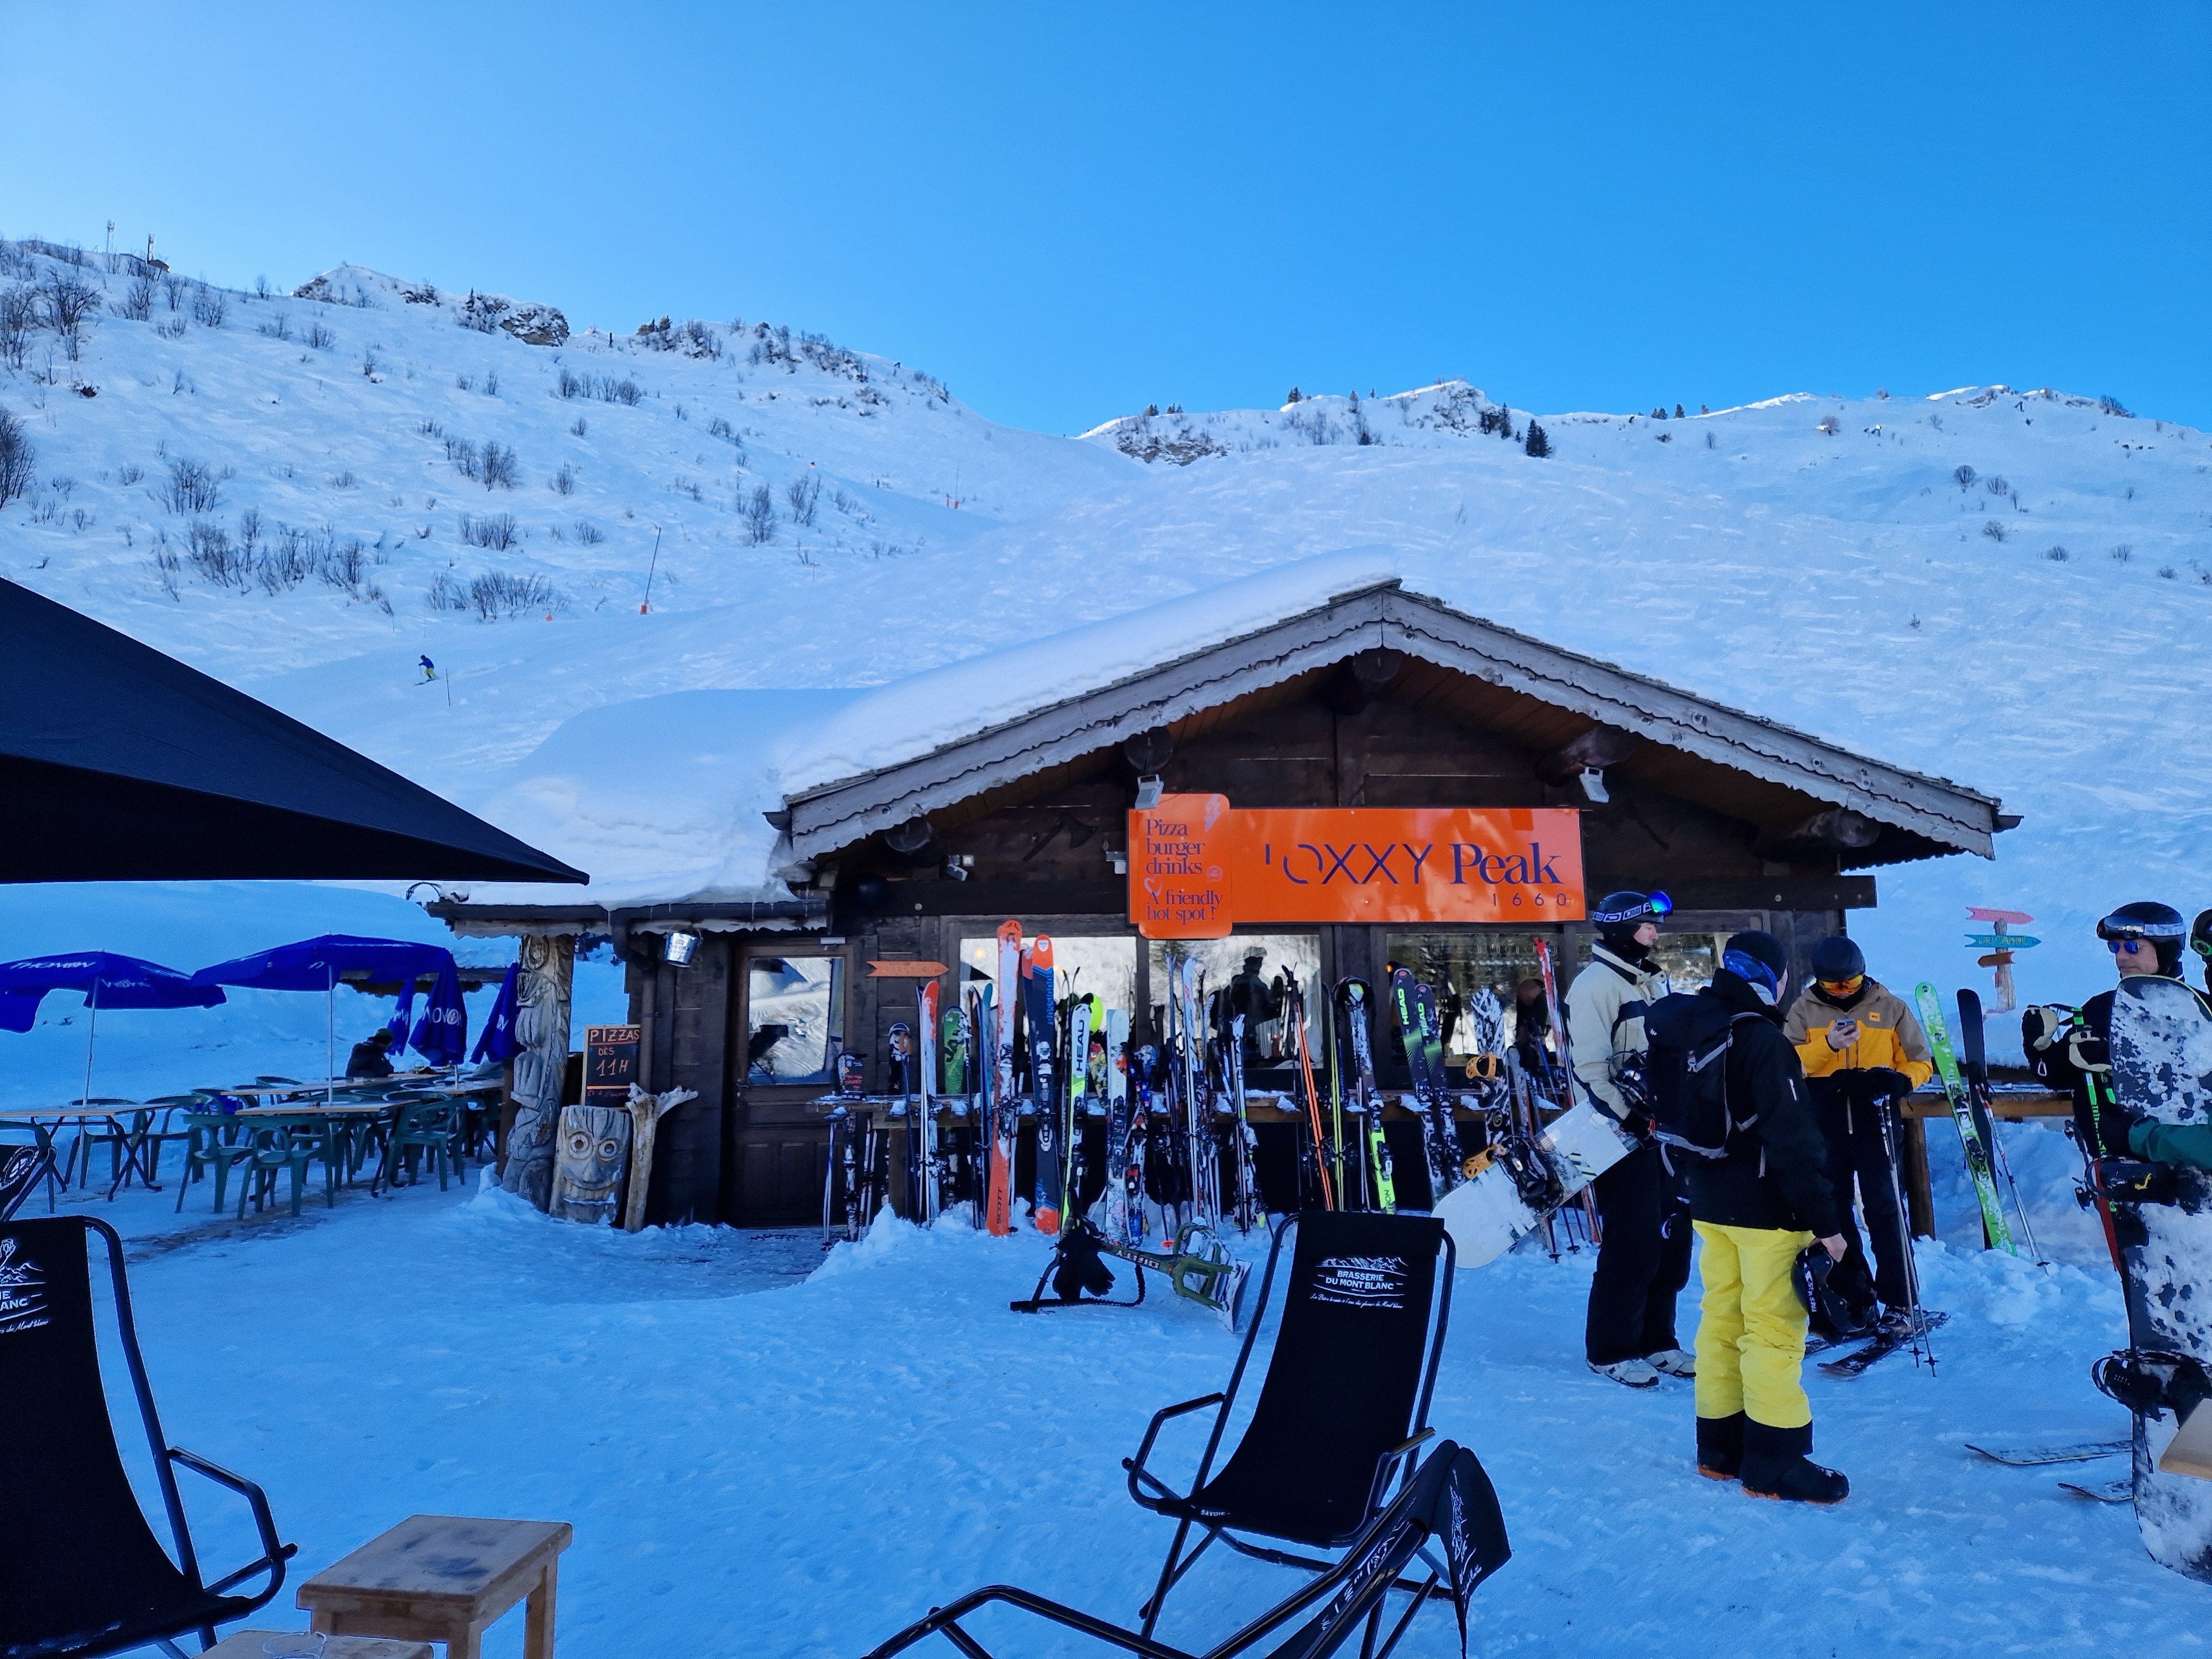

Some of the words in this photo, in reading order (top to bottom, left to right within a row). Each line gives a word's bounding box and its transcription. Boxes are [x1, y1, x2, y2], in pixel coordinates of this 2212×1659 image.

[1146, 819, 1188, 836] Pizza
[1146, 838, 1206, 860] burger
[1146, 857, 1203, 874] drinks
[1448, 842, 1564, 885] Peak
[1147, 891, 1160, 905] A
[1165, 889, 1223, 910] friendly
[1146, 905, 1171, 921] hot
[1175, 906, 1207, 925] spot
[1397, 988, 1410, 1025] HEAD
[589, 1029, 640, 1042] PIZZAS
[1076, 1019, 1084, 1072] HEAD
[1337, 1270, 1385, 1282] BRASSERIE
[1339, 1278, 1364, 1289] MONT
[1364, 1282, 1395, 1290] BLANC
